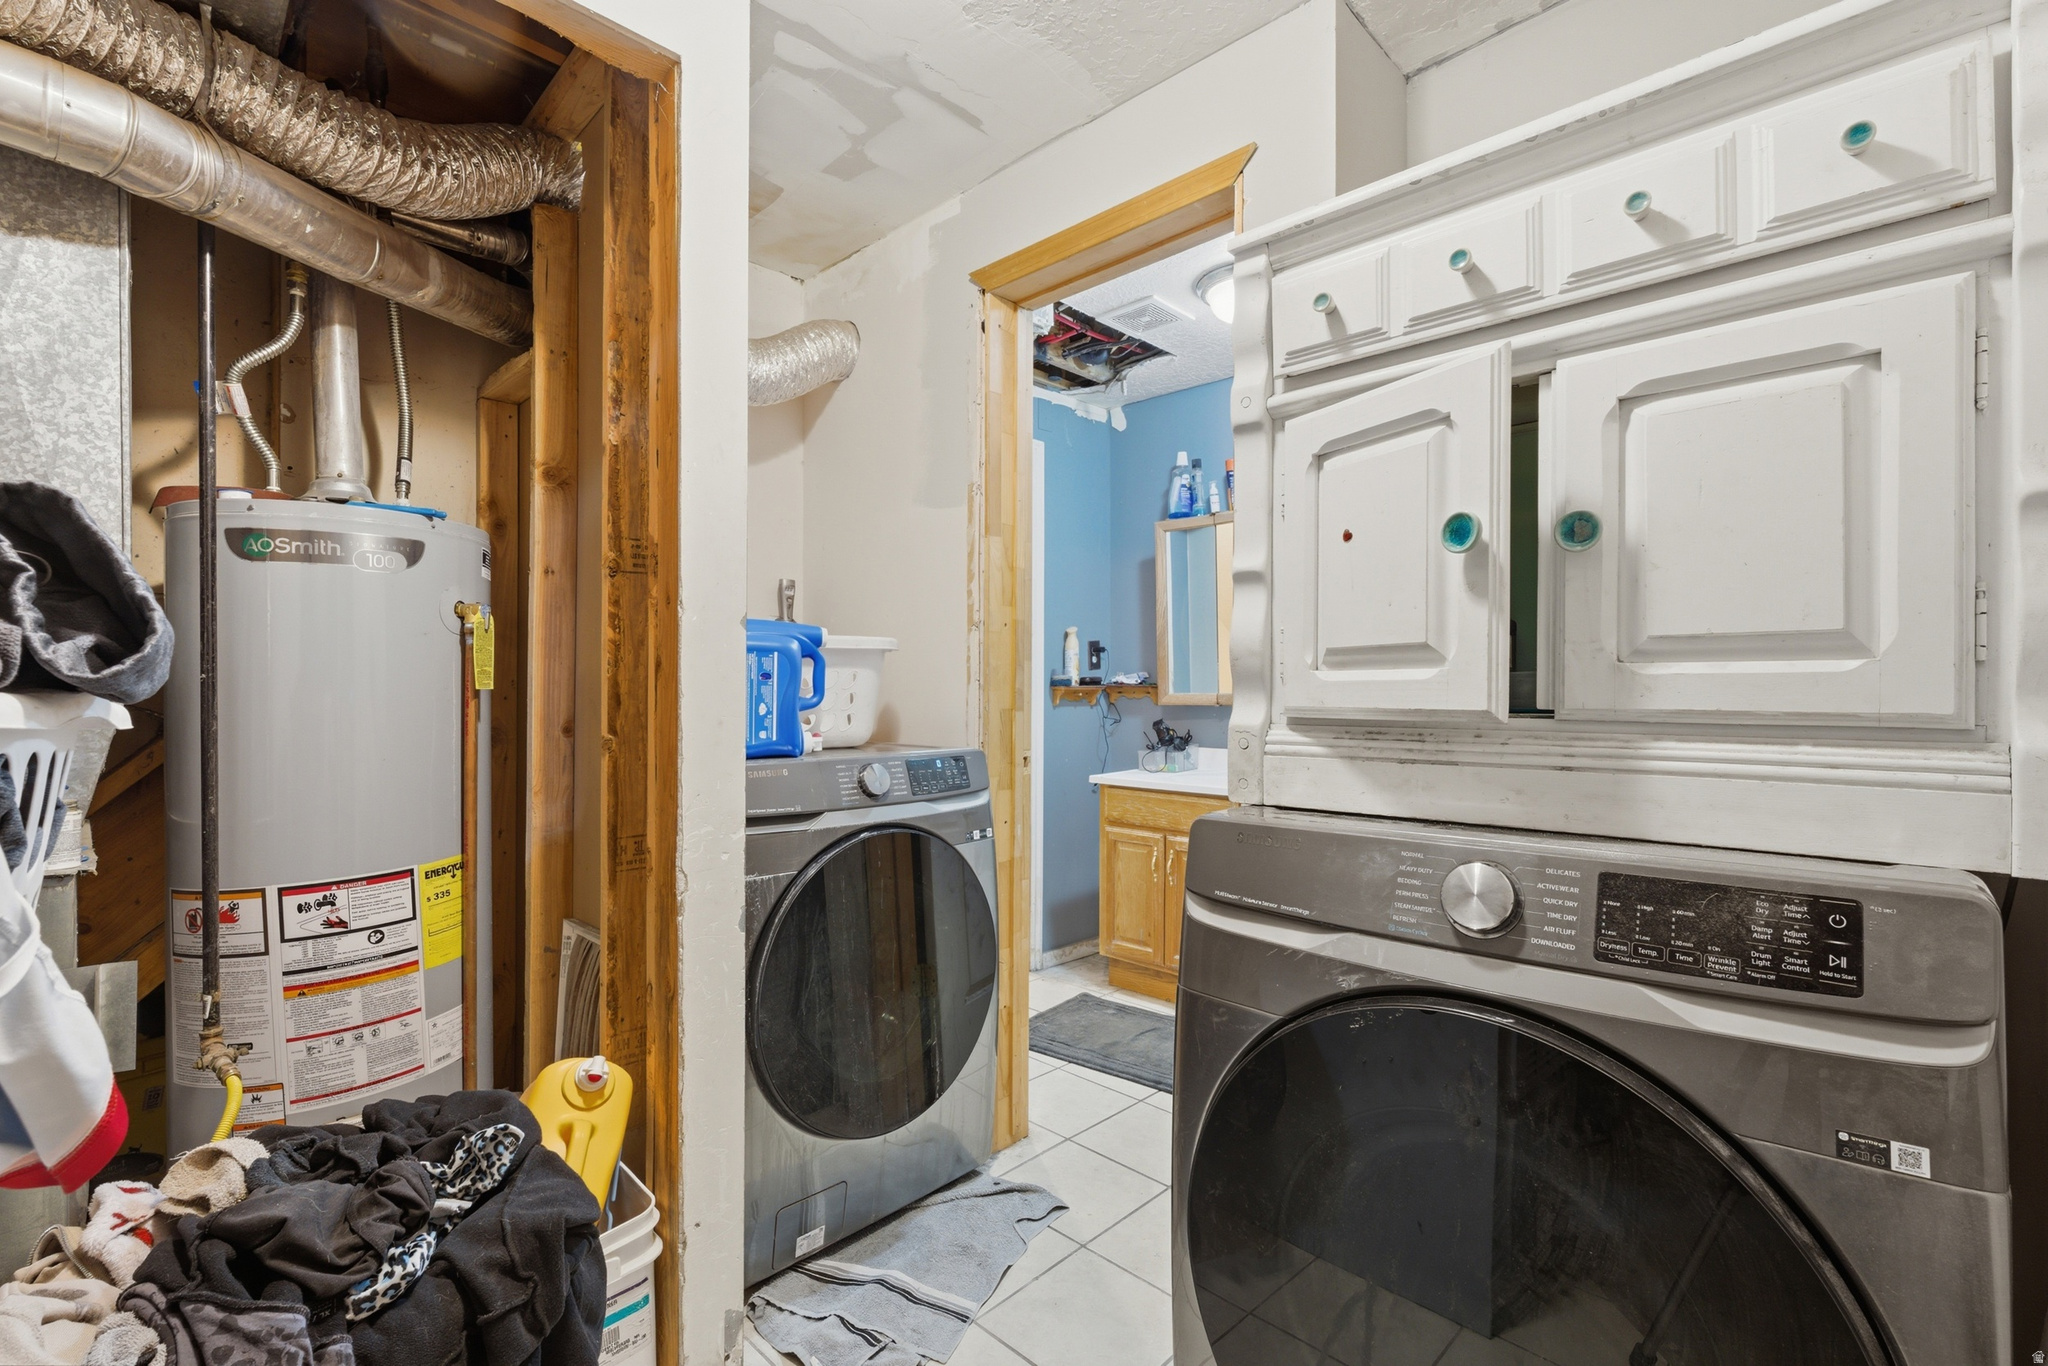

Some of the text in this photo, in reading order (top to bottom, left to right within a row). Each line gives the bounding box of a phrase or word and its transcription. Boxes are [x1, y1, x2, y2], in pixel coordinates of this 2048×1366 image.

[366, 553, 396, 569] 100
[747, 768, 789, 779] SAMSUNG
[1401, 851, 1424, 859] NORMAL
[1545, 868, 1581, 878] DELICATES
[339, 880, 367, 890] DANGER
[1397, 877, 1422, 886] BEDDING
[1536, 882, 1580, 894] ACTIVEWEAR
[433, 889, 451, 901] 335
[1395, 889, 1429, 900] PERM PRESS
[1394, 901, 1411, 910] STEAM
[1542, 897, 1579, 908] QUICK DRY
[1755, 907, 1769, 915] Dry
[1783, 904, 1808, 912] Adjust
[1392, 914, 1417, 924] REFRESH
[1546, 911, 1578, 922] TIME DRY
[1783, 910, 1802, 919] Time
[1543, 925, 1577, 936] AIR FLUFF
[1751, 925, 1773, 934] Damp
[1783, 929, 1808, 938] Adjust
[1752, 932, 1772, 940] Alert
[1783, 936, 1802, 945] Time
[1530, 937, 1576, 951] DOWNLOADED
[1599, 941, 1627, 951] Dryness
[1637, 947, 1659, 957] Temp.
[1750, 951, 1772, 960] Drum
[1674, 952, 1694, 963] Time
[1707, 955, 1737, 966] Wrinkle
[1784, 956, 1808, 965] Smart
[1707, 962, 1737, 973] Prevent
[1751, 959, 1771, 967] Light
[1781, 963, 1810, 973] Control
